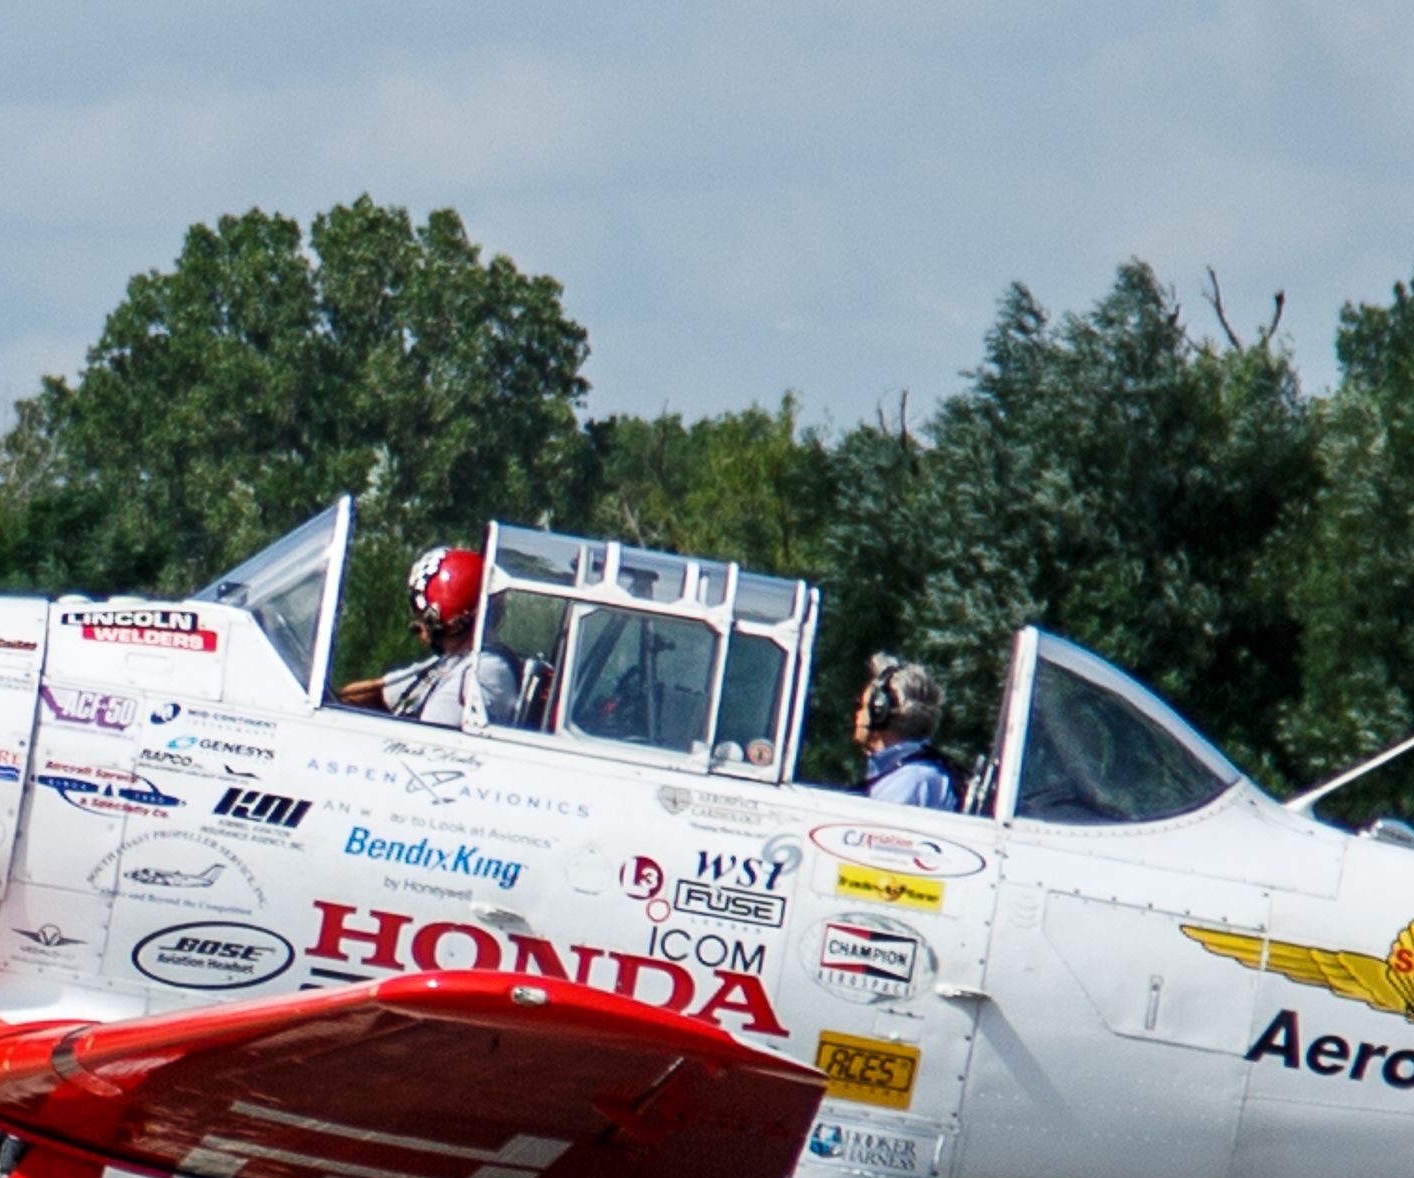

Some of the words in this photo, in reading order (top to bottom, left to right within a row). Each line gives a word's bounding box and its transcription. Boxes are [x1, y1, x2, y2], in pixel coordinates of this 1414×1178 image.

[67, 611, 192, 632] LINCOLN
[93, 626, 204, 650] WELDERS
[139, 749, 193, 767] RAPCO
[199, 738, 275, 760] GENESYS
[306, 758, 397, 783] ASPEN
[459, 785, 590, 818] AVIONICS
[429, 815, 466, 834] Look
[152, 830, 218, 850] PROPELLER
[344, 826, 522, 890] BendixKing
[698, 850, 785, 890] WSI
[383, 875, 399, 891] by
[403, 879, 474, 901] Honeywell
[684, 886, 774, 921] FUSE
[159, 936, 276, 962] BOSE
[649, 926, 767, 975] ICOM
[829, 938, 908, 966] CHAMPION
[156, 951, 204, 969] Aviation
[207, 955, 255, 974] Headset
[305, 900, 791, 1038] HONDA
[827, 1048, 897, 1086] ACES
[844, 1129, 916, 1153] HOOKER
[843, 1150, 916, 1172] HARNESS
